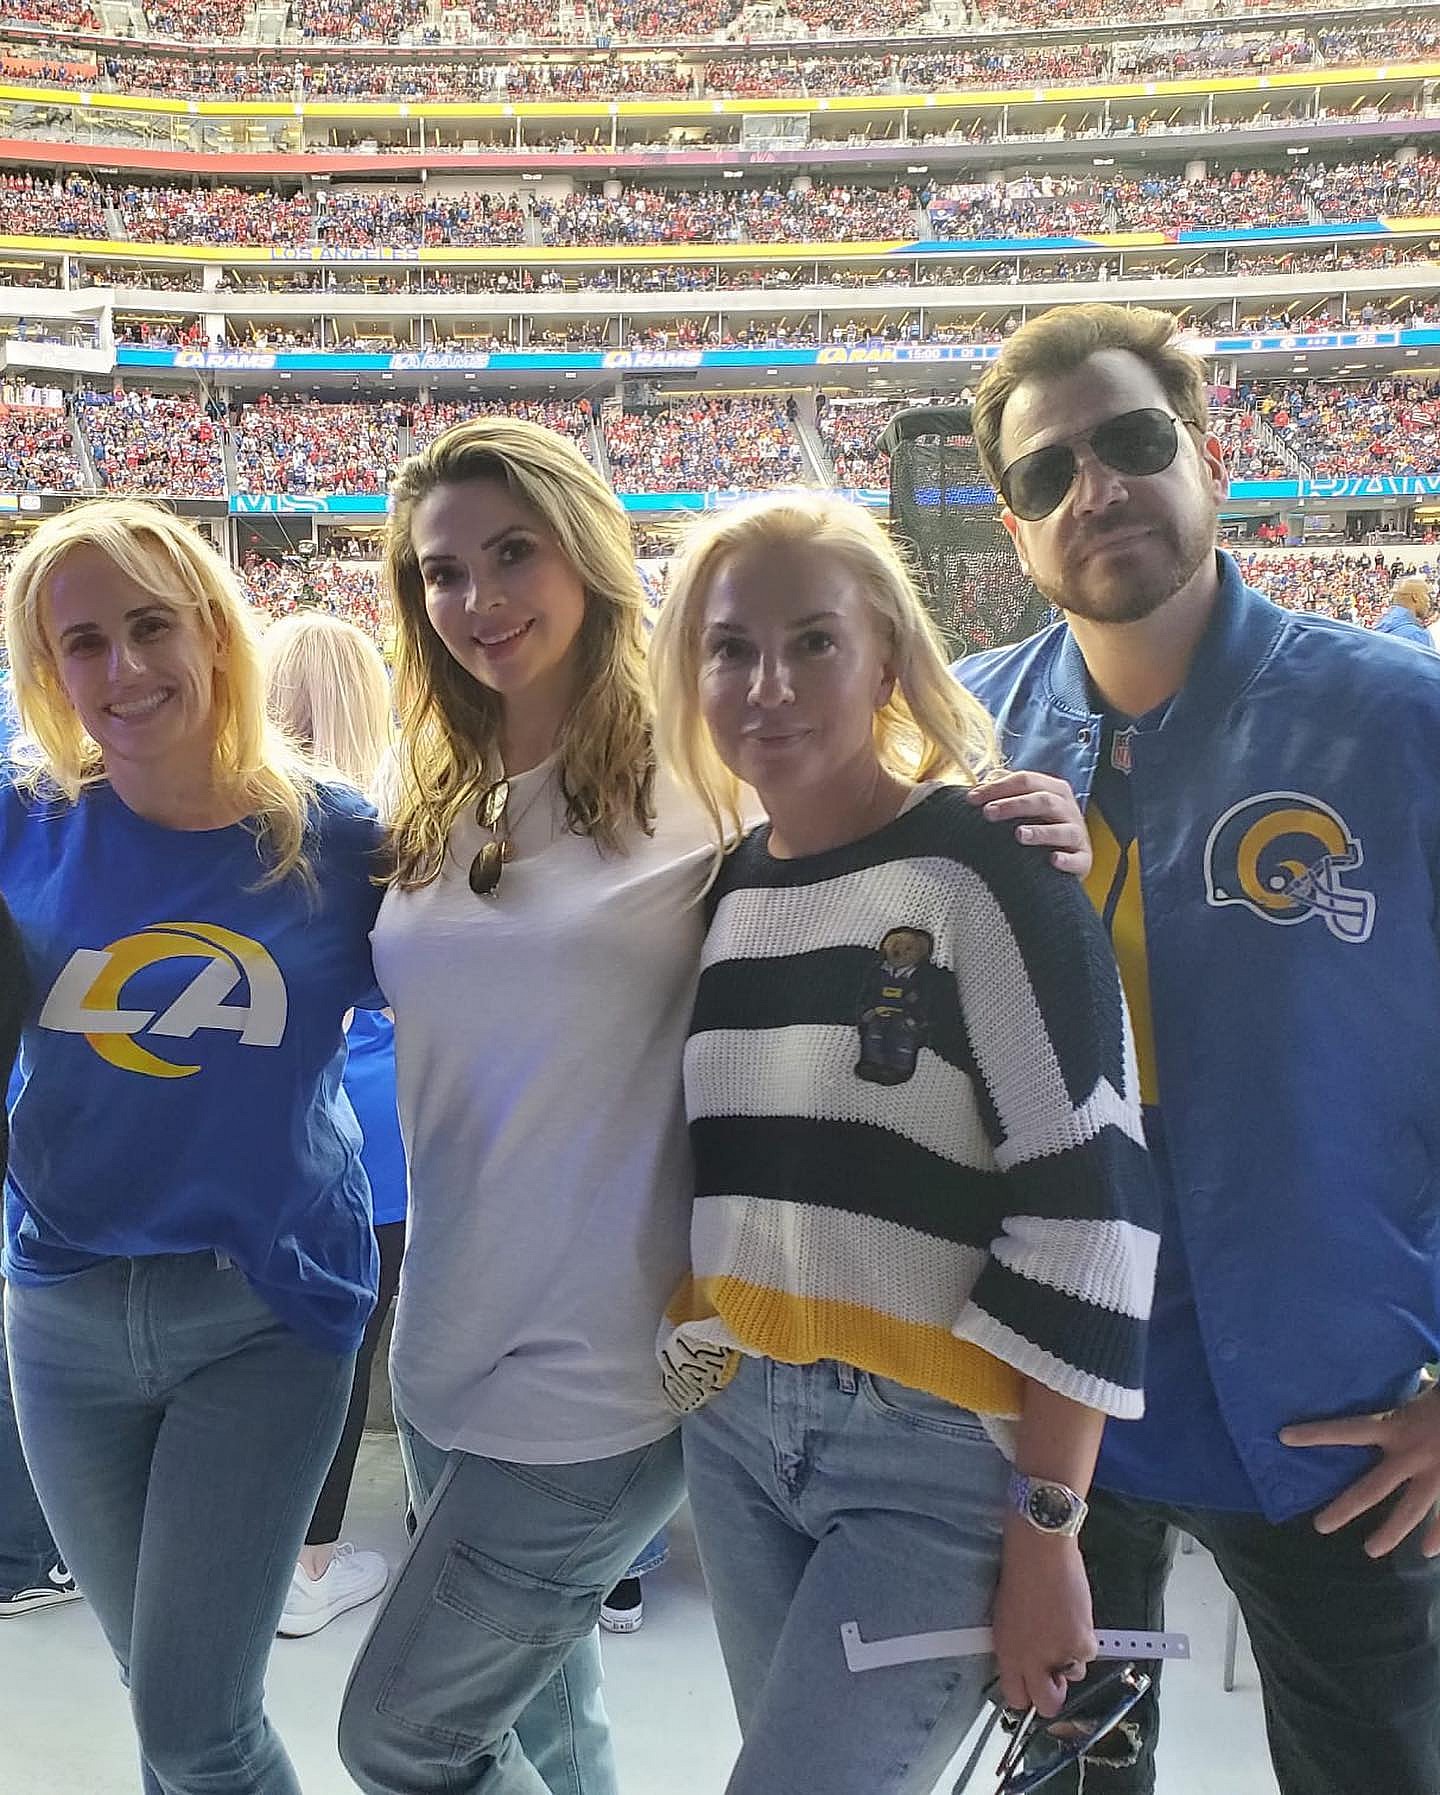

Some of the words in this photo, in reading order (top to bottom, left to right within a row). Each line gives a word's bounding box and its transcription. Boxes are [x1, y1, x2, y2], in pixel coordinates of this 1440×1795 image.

[271, 248, 312, 260] LOS
[319, 248, 419, 261] ANGELES
[206, 353, 276, 369] RAMS
[421, 353, 489, 369] RAMS
[633, 352, 702, 368] RAMS
[38, 920, 290, 1078] LA
